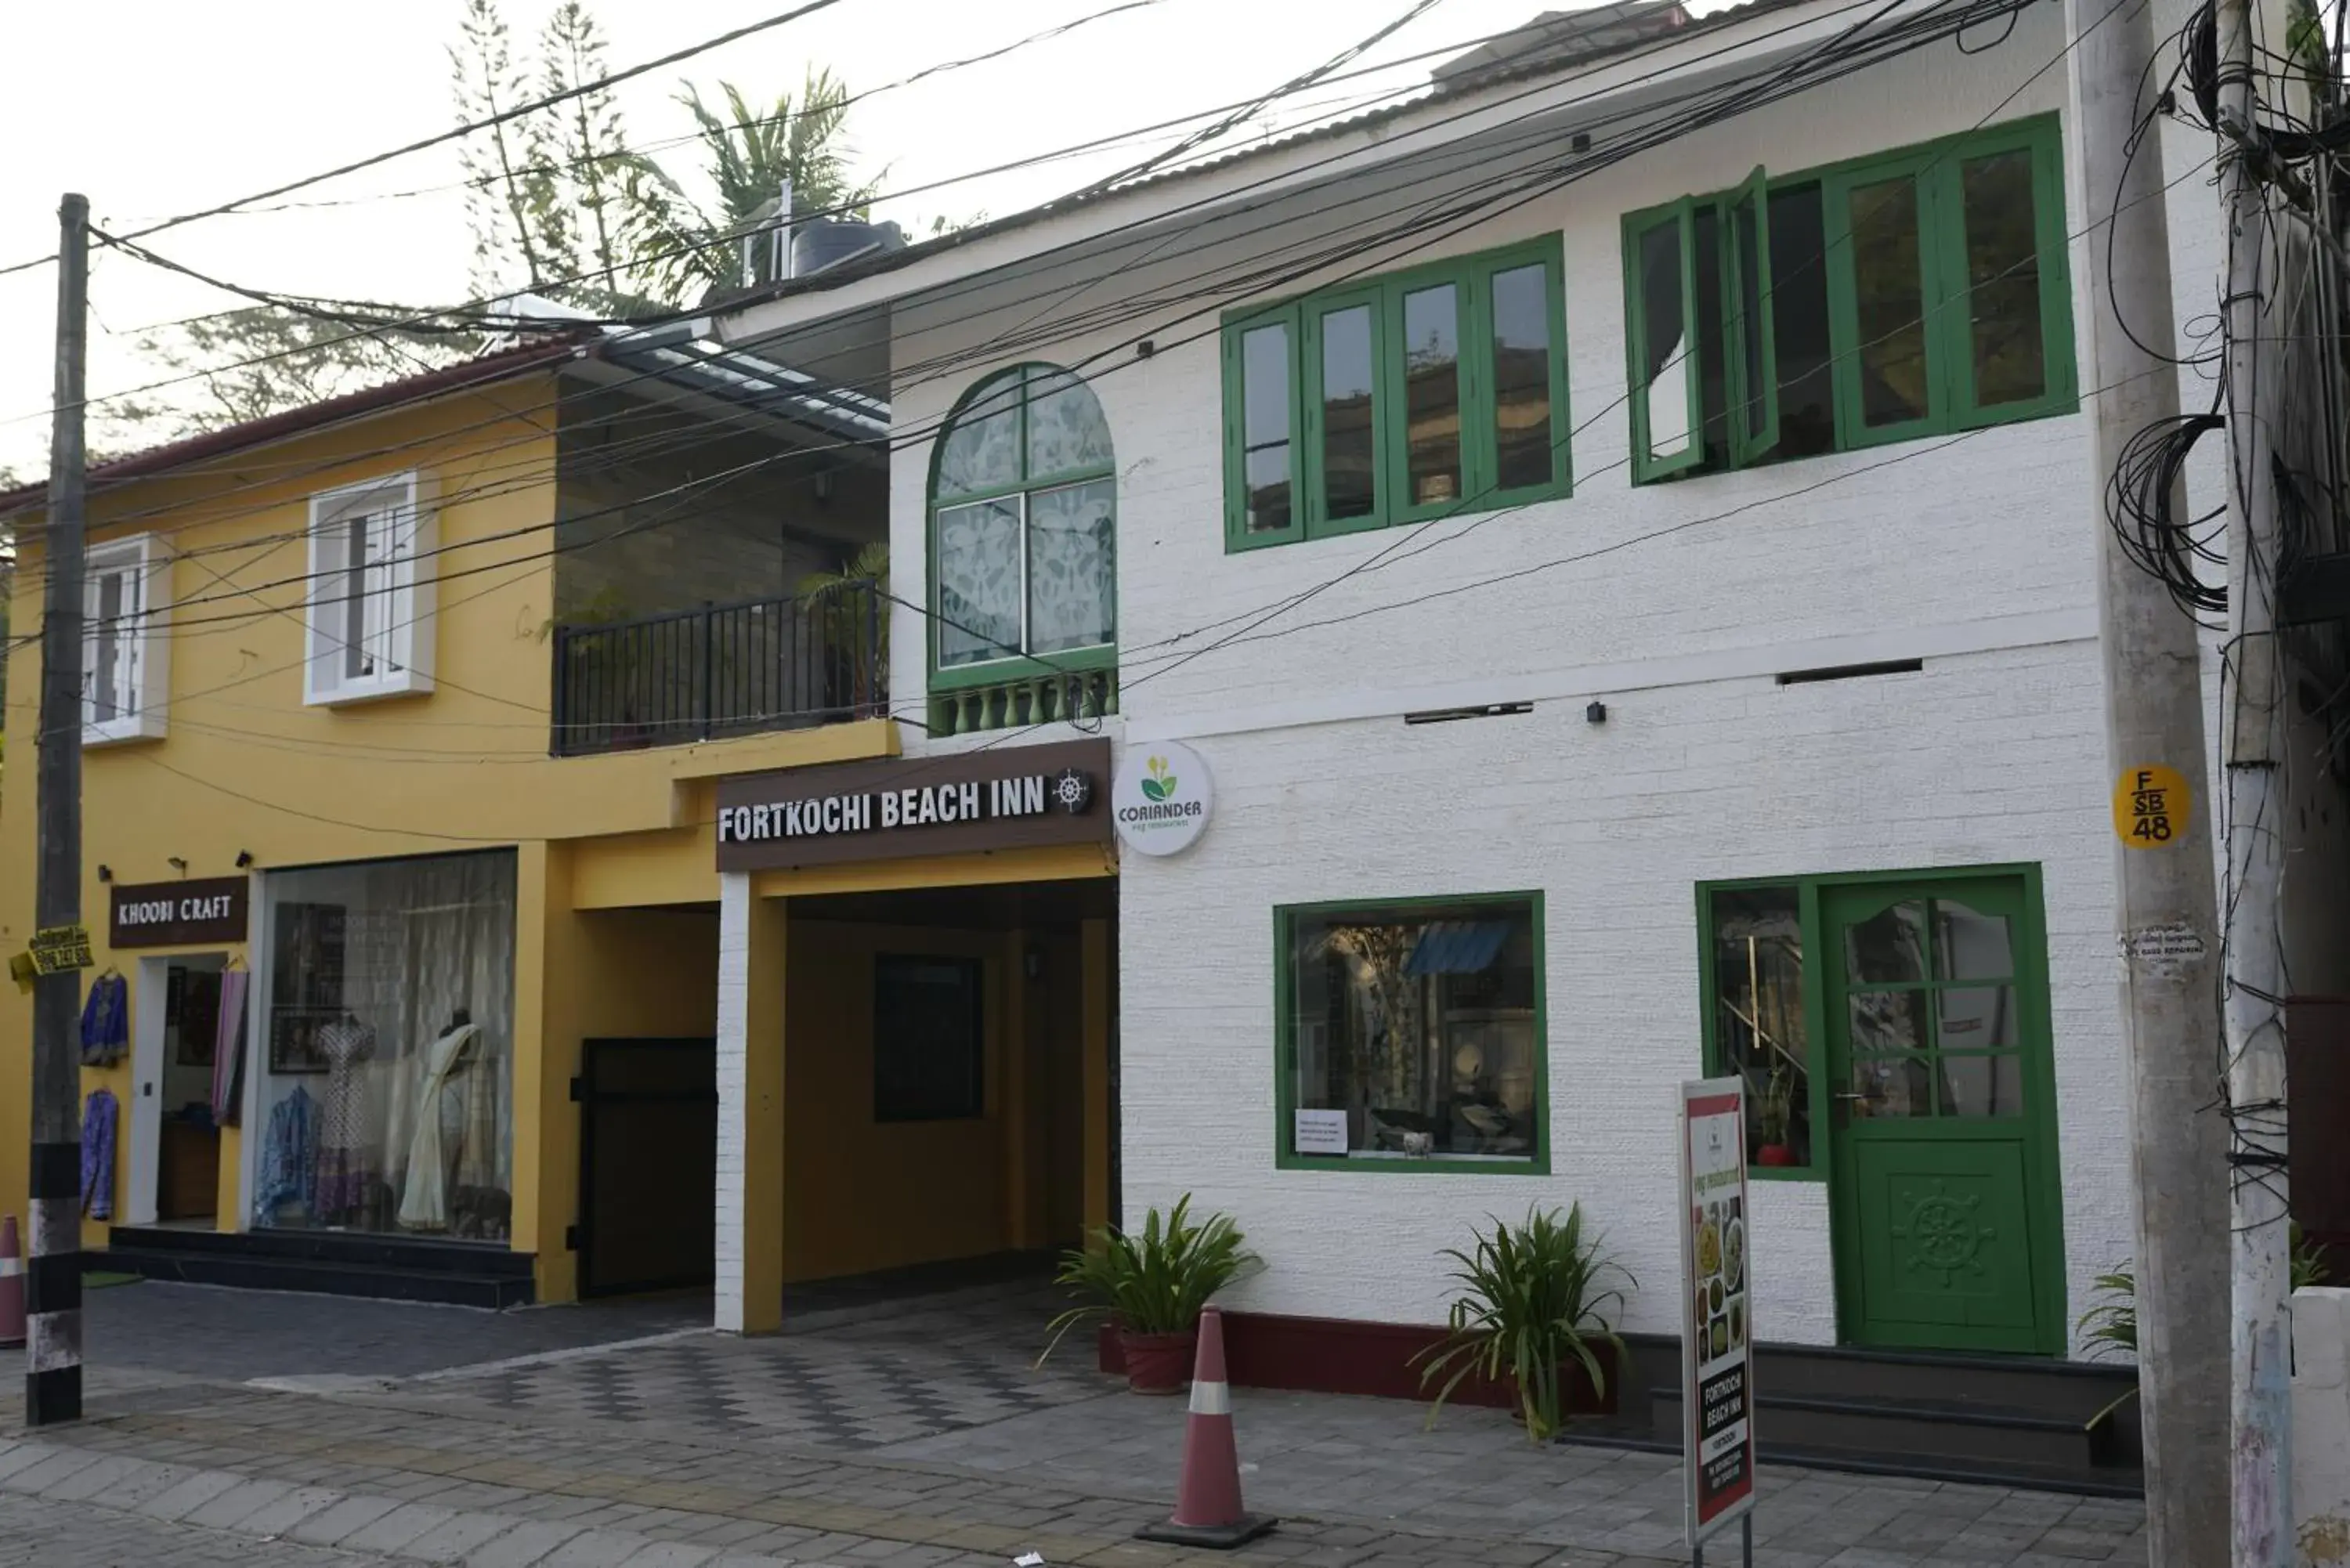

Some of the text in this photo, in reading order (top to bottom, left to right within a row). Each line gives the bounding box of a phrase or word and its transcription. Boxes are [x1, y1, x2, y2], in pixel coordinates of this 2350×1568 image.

[2136, 770, 2153, 790] F
[718, 775, 1045, 843] FORTKOCHI BEACH INN
[1118, 800, 1202, 822] CORIANDER
[2133, 793, 2165, 812] SB
[2131, 815, 2172, 841] 48
[118, 895, 232, 926] KHOOBI CRAFT
